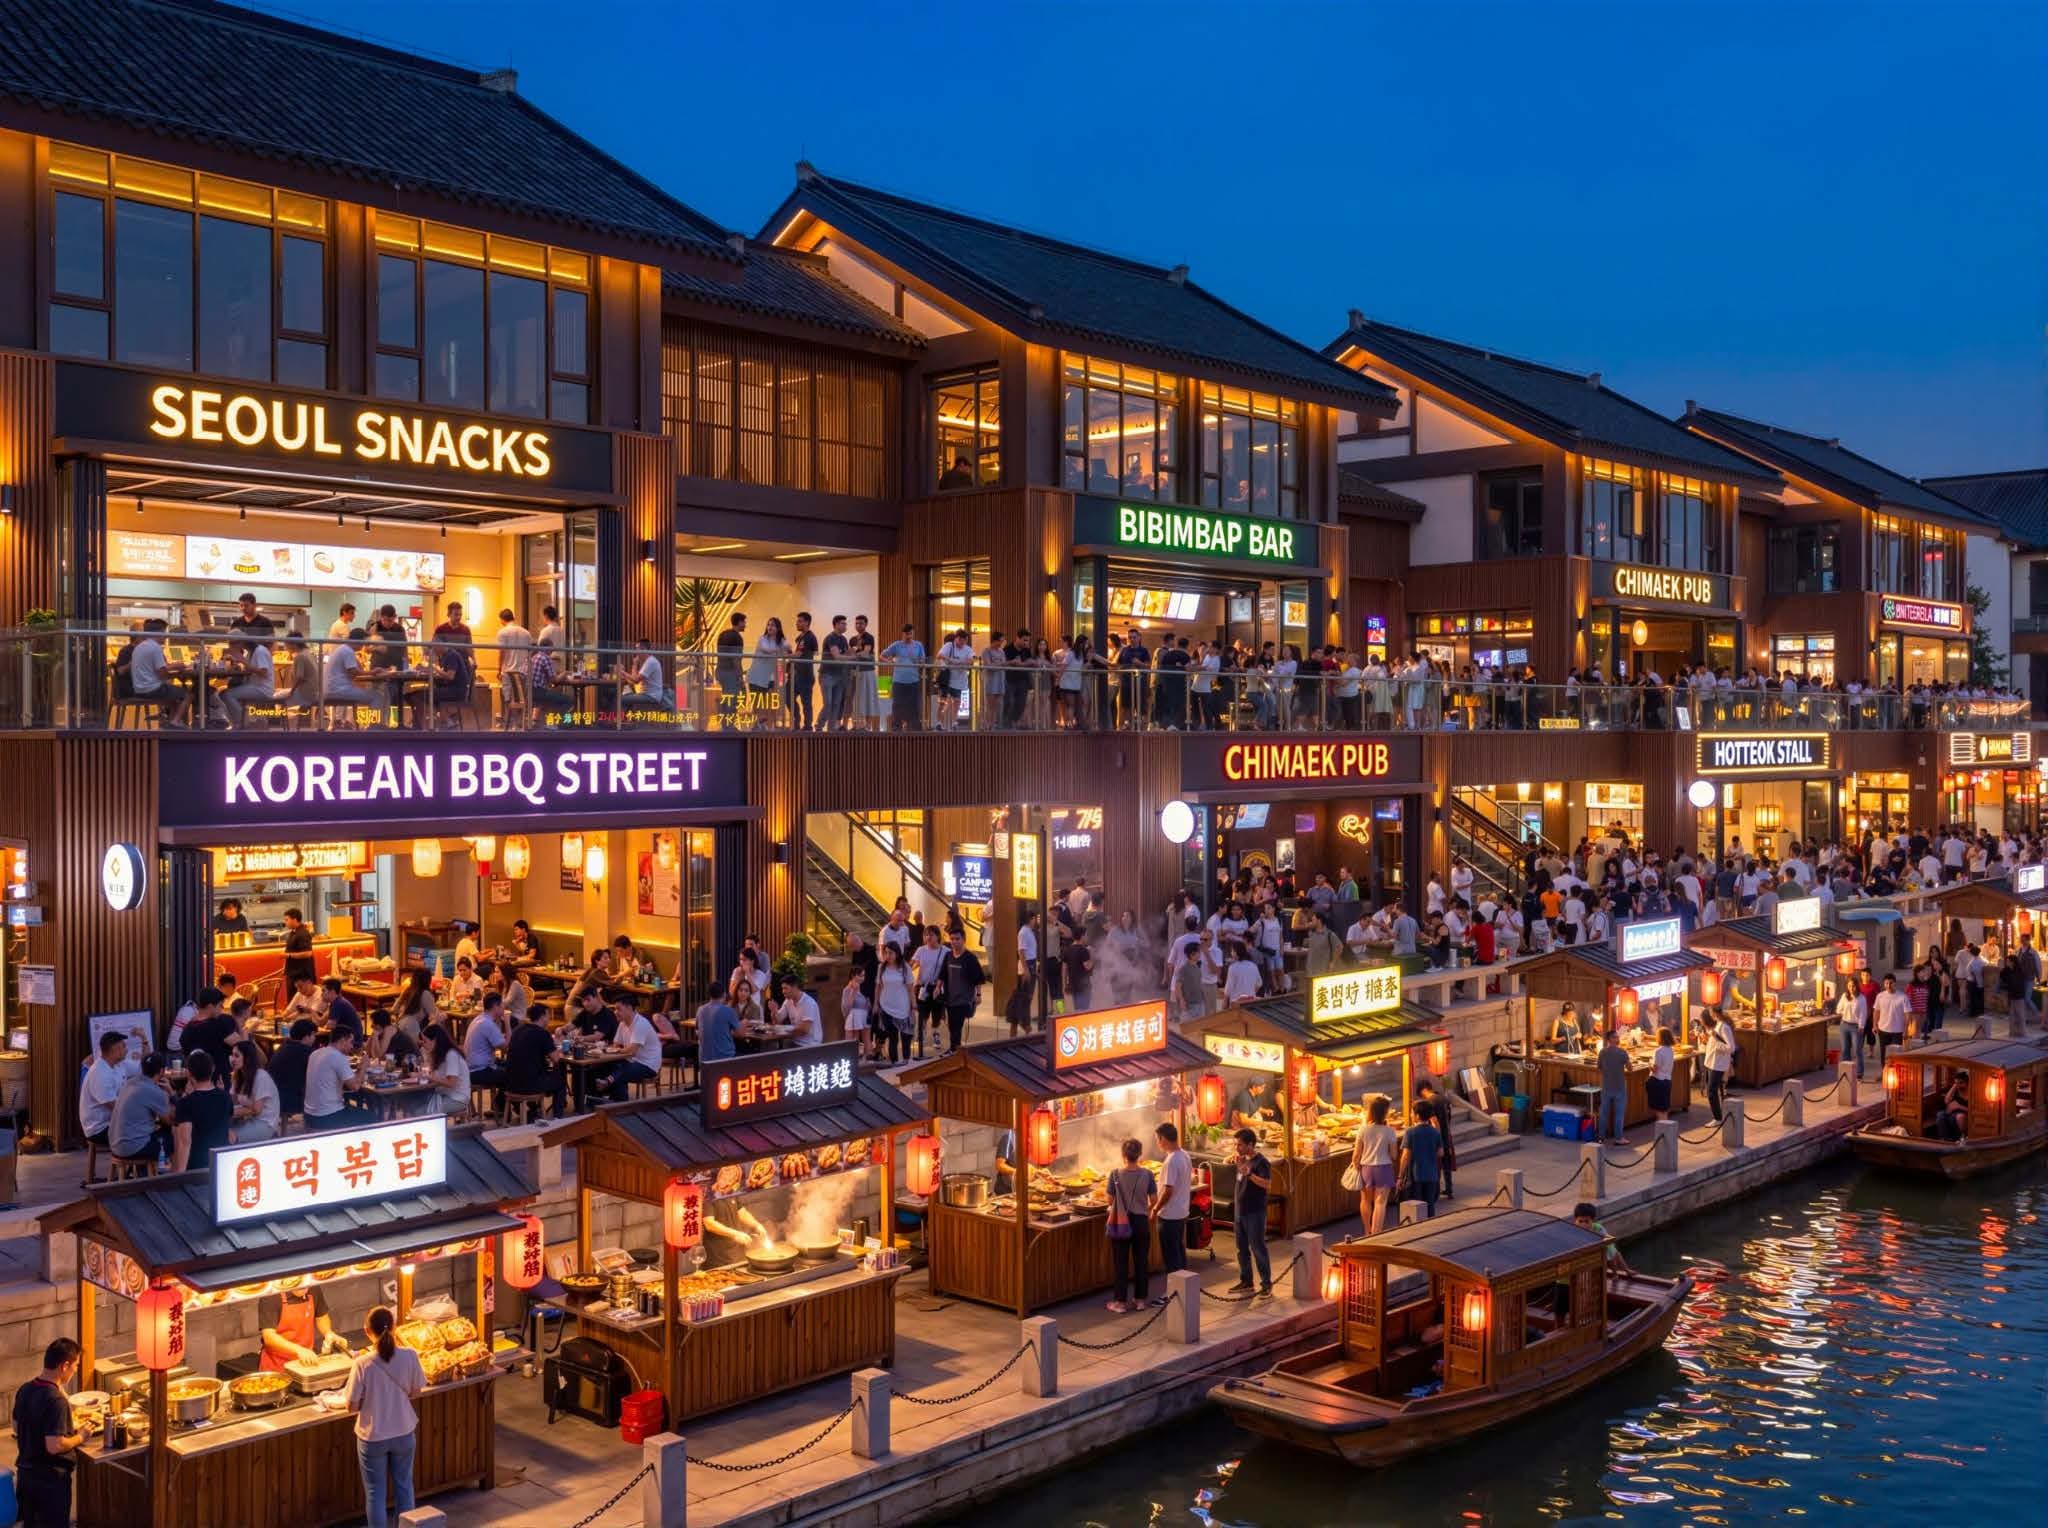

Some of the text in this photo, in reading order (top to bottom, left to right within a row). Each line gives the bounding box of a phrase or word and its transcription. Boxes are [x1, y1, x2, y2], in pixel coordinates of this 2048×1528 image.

[150, 385, 551, 477] SEOUL SNACKS
[1119, 507, 1294, 559] BIBIMBAP BAR
[1615, 568, 1712, 603] CHIMAEK PUB
[1224, 743, 1390, 780] CHIMAEK PUB
[1715, 740, 1813, 766] HOTTEOK STALL
[224, 751, 708, 806] KOREAN BBQ STREET
